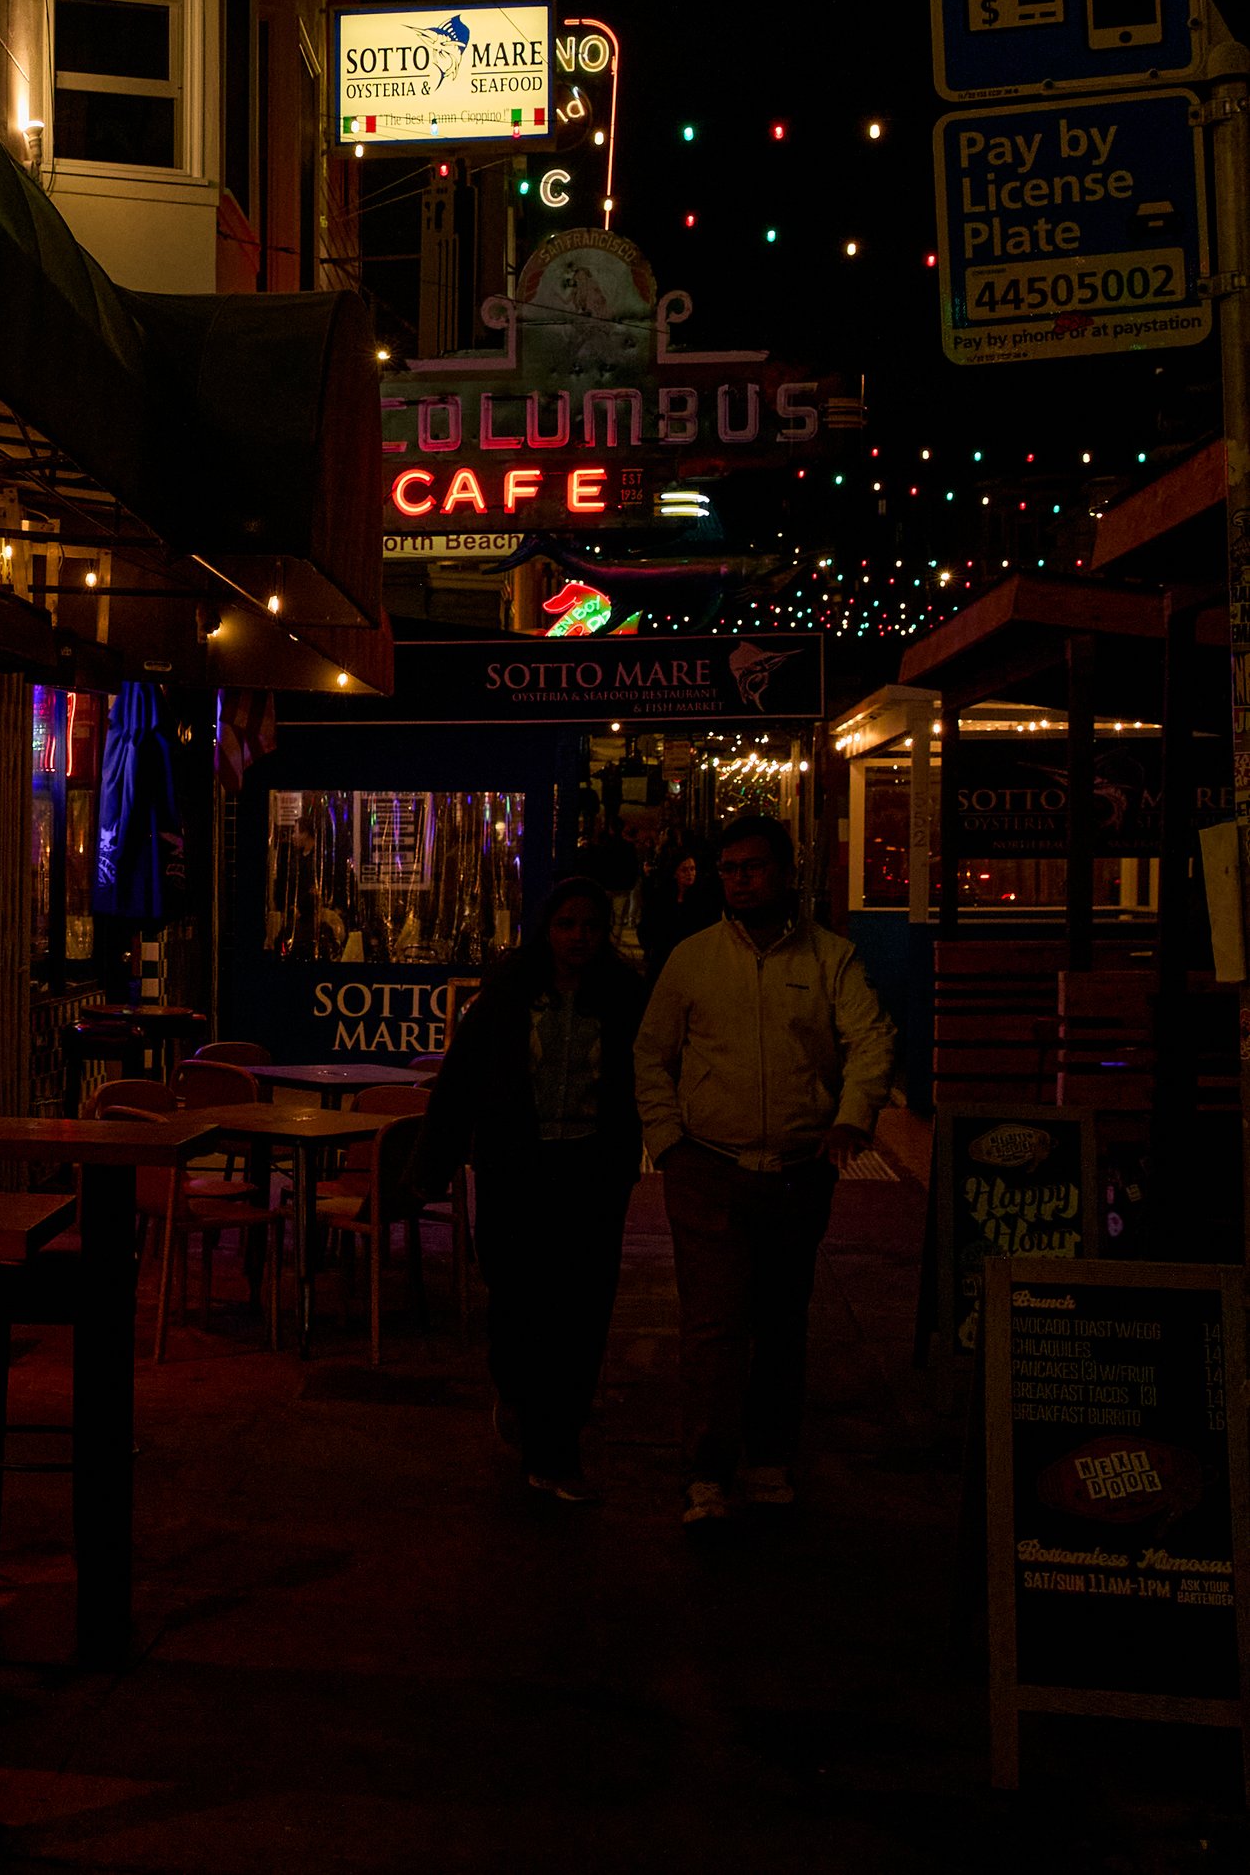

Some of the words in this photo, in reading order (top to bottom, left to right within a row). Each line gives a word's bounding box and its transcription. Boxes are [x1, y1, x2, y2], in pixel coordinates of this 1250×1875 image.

[346, 44, 431, 75] SOTTO
[471, 40, 544, 69] MARE
[346, 80, 416, 99] OYSTERIA
[420, 80, 431, 97] &
[470, 75, 543, 95] SEAFOOD
[406, 112, 424, 126] Best
[428, 111, 457, 125] Damn
[959, 130, 1044, 174] Pay
[1058, 117, 1119, 166] by
[961, 168, 1135, 215] License
[539, 238, 566, 264] SAN
[564, 231, 638, 262] FRANCISCO
[963, 215, 1082, 260] Plate
[975, 265, 1176, 313] 44505002
[953, 336, 982, 351] Pay
[987, 332, 1008, 349] by
[1012, 329, 1066, 348] phone
[1069, 328, 1087, 339] or
[1091, 324, 1109, 338] at
[1114, 315, 1202, 338] paystation
[391, 466, 607, 517] CAFE
[621, 472, 642, 486] EST
[620, 488, 644, 501] 1936
[383, 535, 434, 552] orth
[445, 533, 520, 550] Beach
[572, 595, 601, 620] BOY
[485, 662, 602, 690] SOTTO
[613, 659, 711, 688] MARE
[511, 690, 569, 702] OYSTERIA
[582, 688, 639, 701] SEAFOOD
[641, 687, 719, 700] RESTAURANT
[645, 702, 674, 712] FISH
[676, 700, 724, 711] MARKET
[957, 788, 1067, 811] SOTTO
[1138, 786, 1235, 810] MRE
[331, 1020, 446, 1053] MARE
[961, 1175, 1080, 1223] Happy
[981, 1215, 1082, 1258] Hour
[1011, 1289, 1077, 1310] Brunch
[1012, 1316, 1071, 1336] AVOCADO
[1072, 1319, 1113, 1338] TOAST
[1012, 1337, 1092, 1359] CHILAQUILES
[1012, 1358, 1079, 1380] PANCAKES
[1012, 1380, 1085, 1402] BREAKFAST
[1087, 1385, 1130, 1405] TACOS
[1012, 1402, 1085, 1424] BREAKFAST
[1087, 1406, 1142, 1427] BURRITO
[1077, 1452, 1148, 1479] NEXT
[1090, 1471, 1161, 1496] DOOR
[1016, 1538, 1130, 1568] Bottomless
[1135, 1546, 1233, 1574] Mimosas
[1023, 1570, 1086, 1592] SAT/SUN
[1180, 1578, 1202, 1591] ASK
[1202, 1579, 1230, 1593] YOUR
